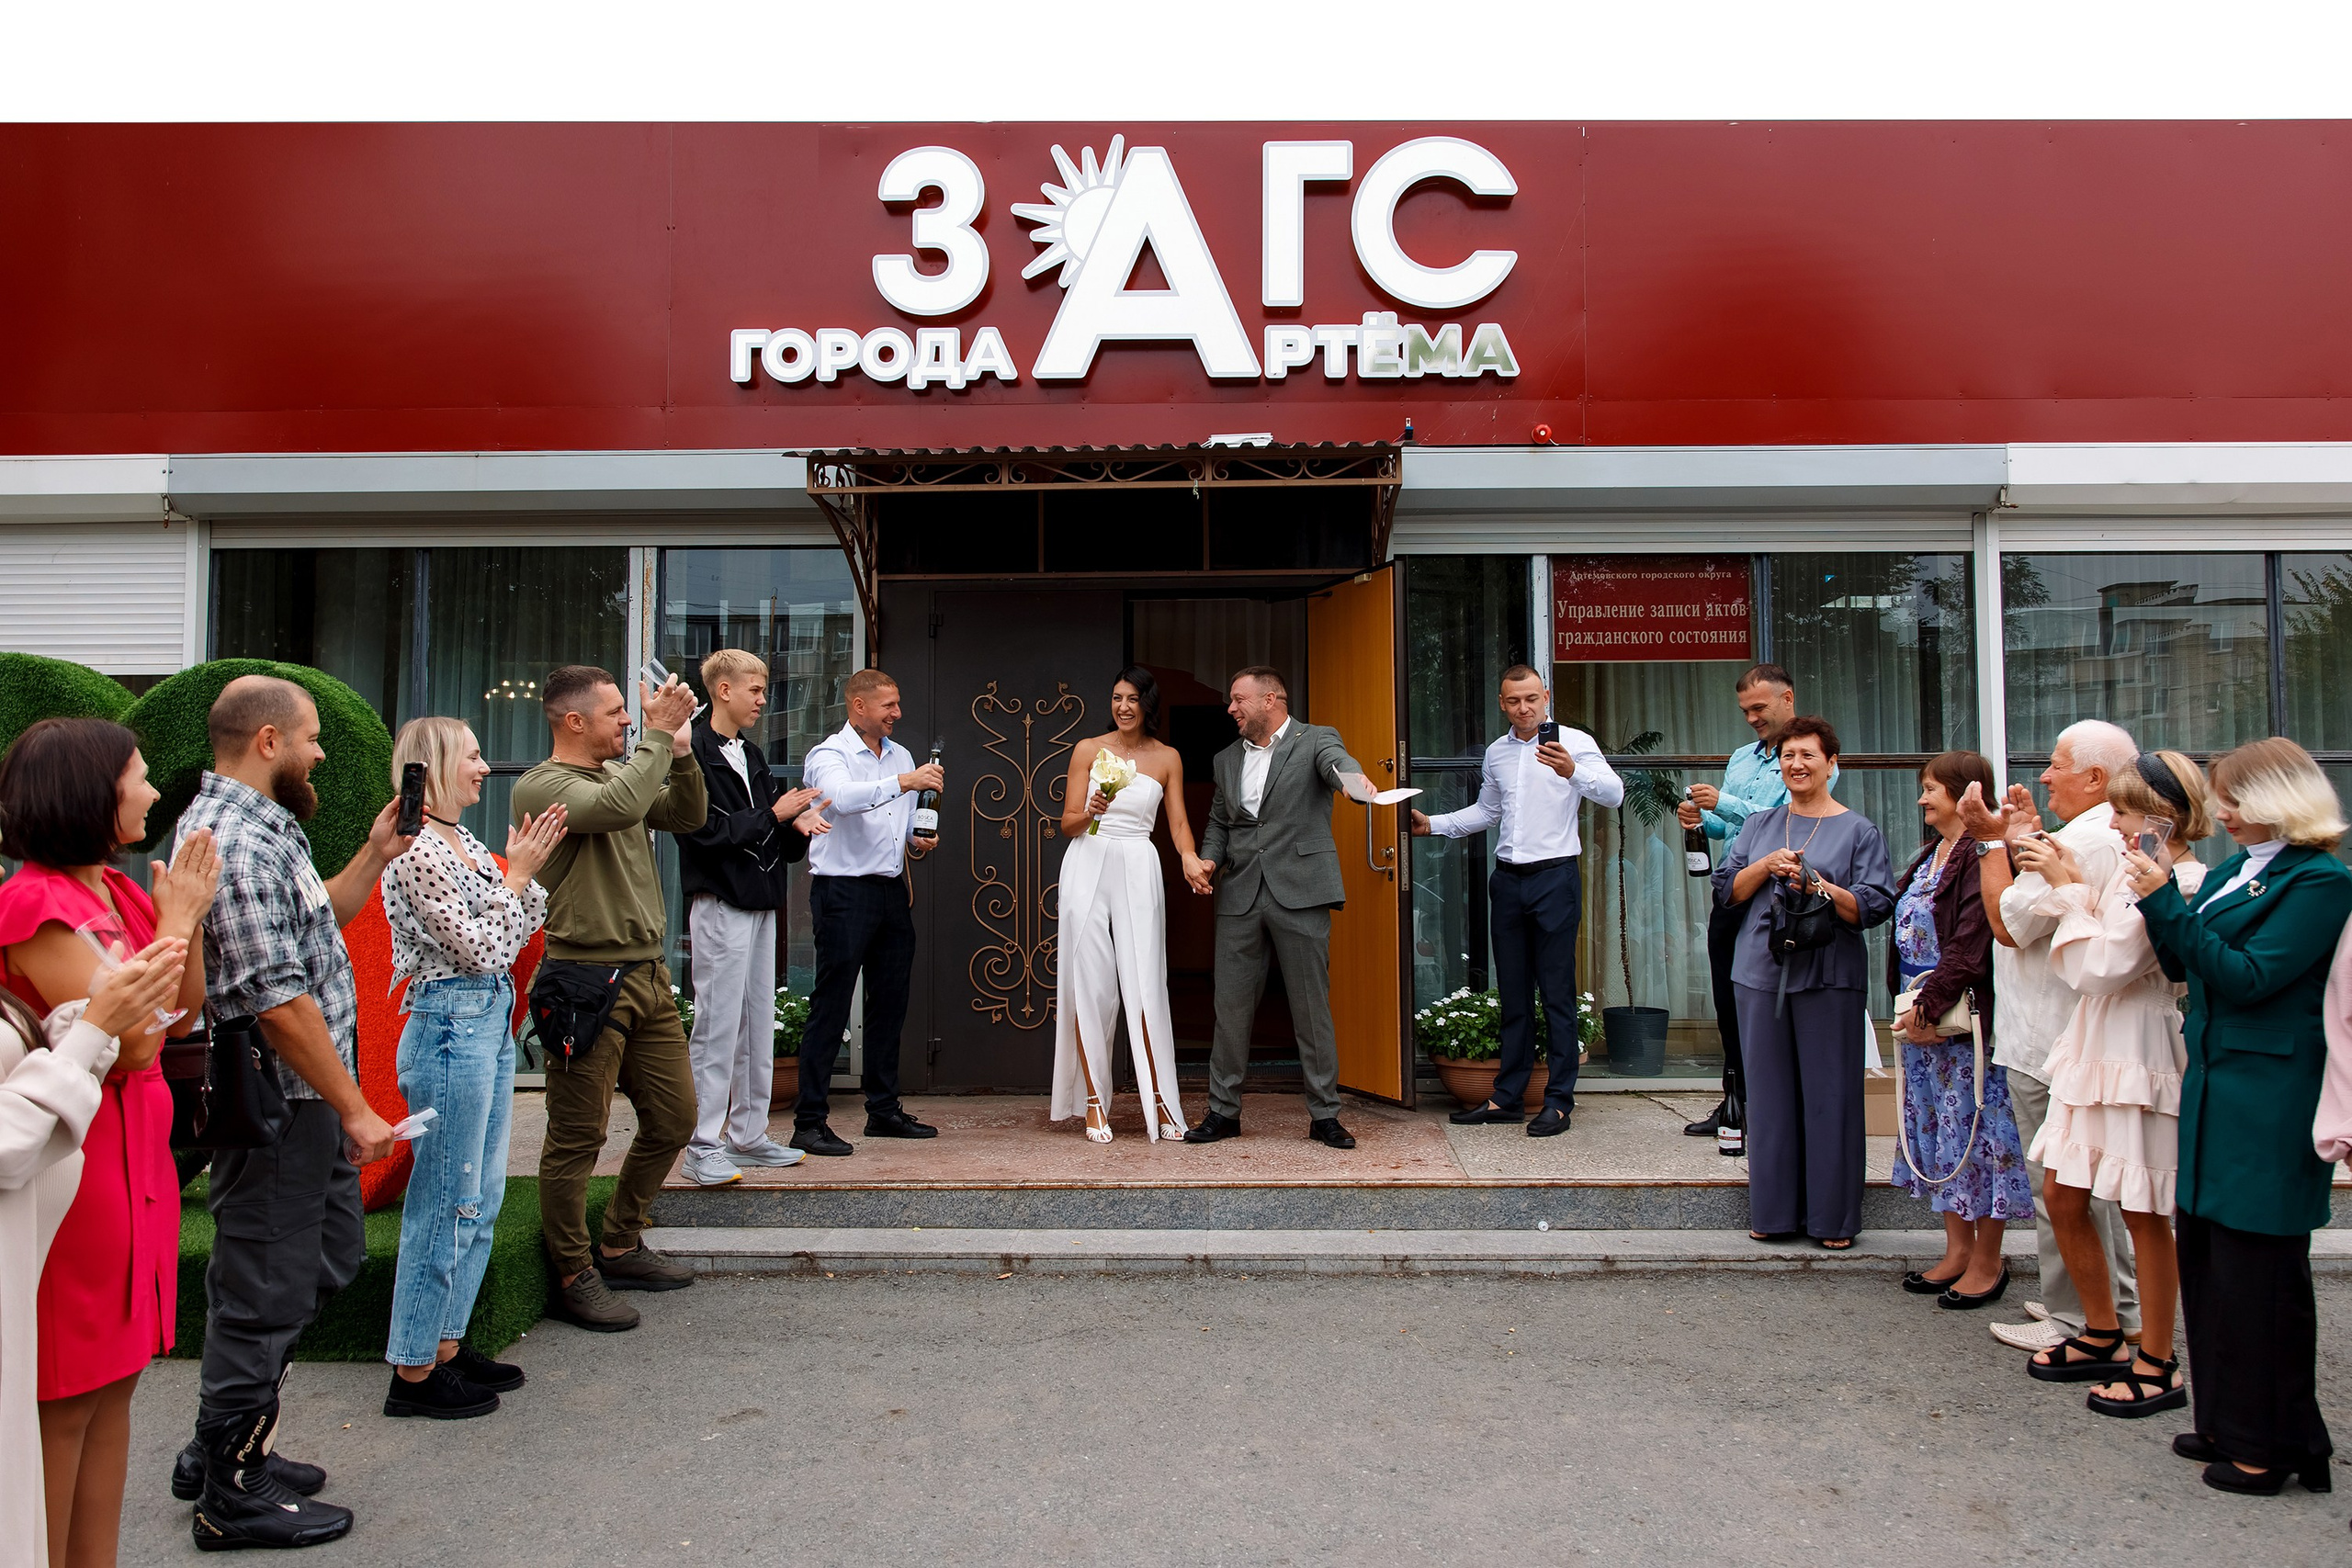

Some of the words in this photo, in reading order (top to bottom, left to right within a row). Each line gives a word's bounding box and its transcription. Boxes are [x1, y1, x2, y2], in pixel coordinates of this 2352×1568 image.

[872, 135, 1519, 382] ЗАГС
[730, 327, 1018, 389] ГОРОДА
[1641, 570, 1694, 581] городского
[1698, 570, 1731, 581] округа
[1557, 600, 1645, 623] Управление
[1650, 604, 1701, 618] записи
[1706, 603, 1747, 618] актов
[1558, 630, 1663, 649] гражданского
[1668, 630, 1747, 644] состояния
